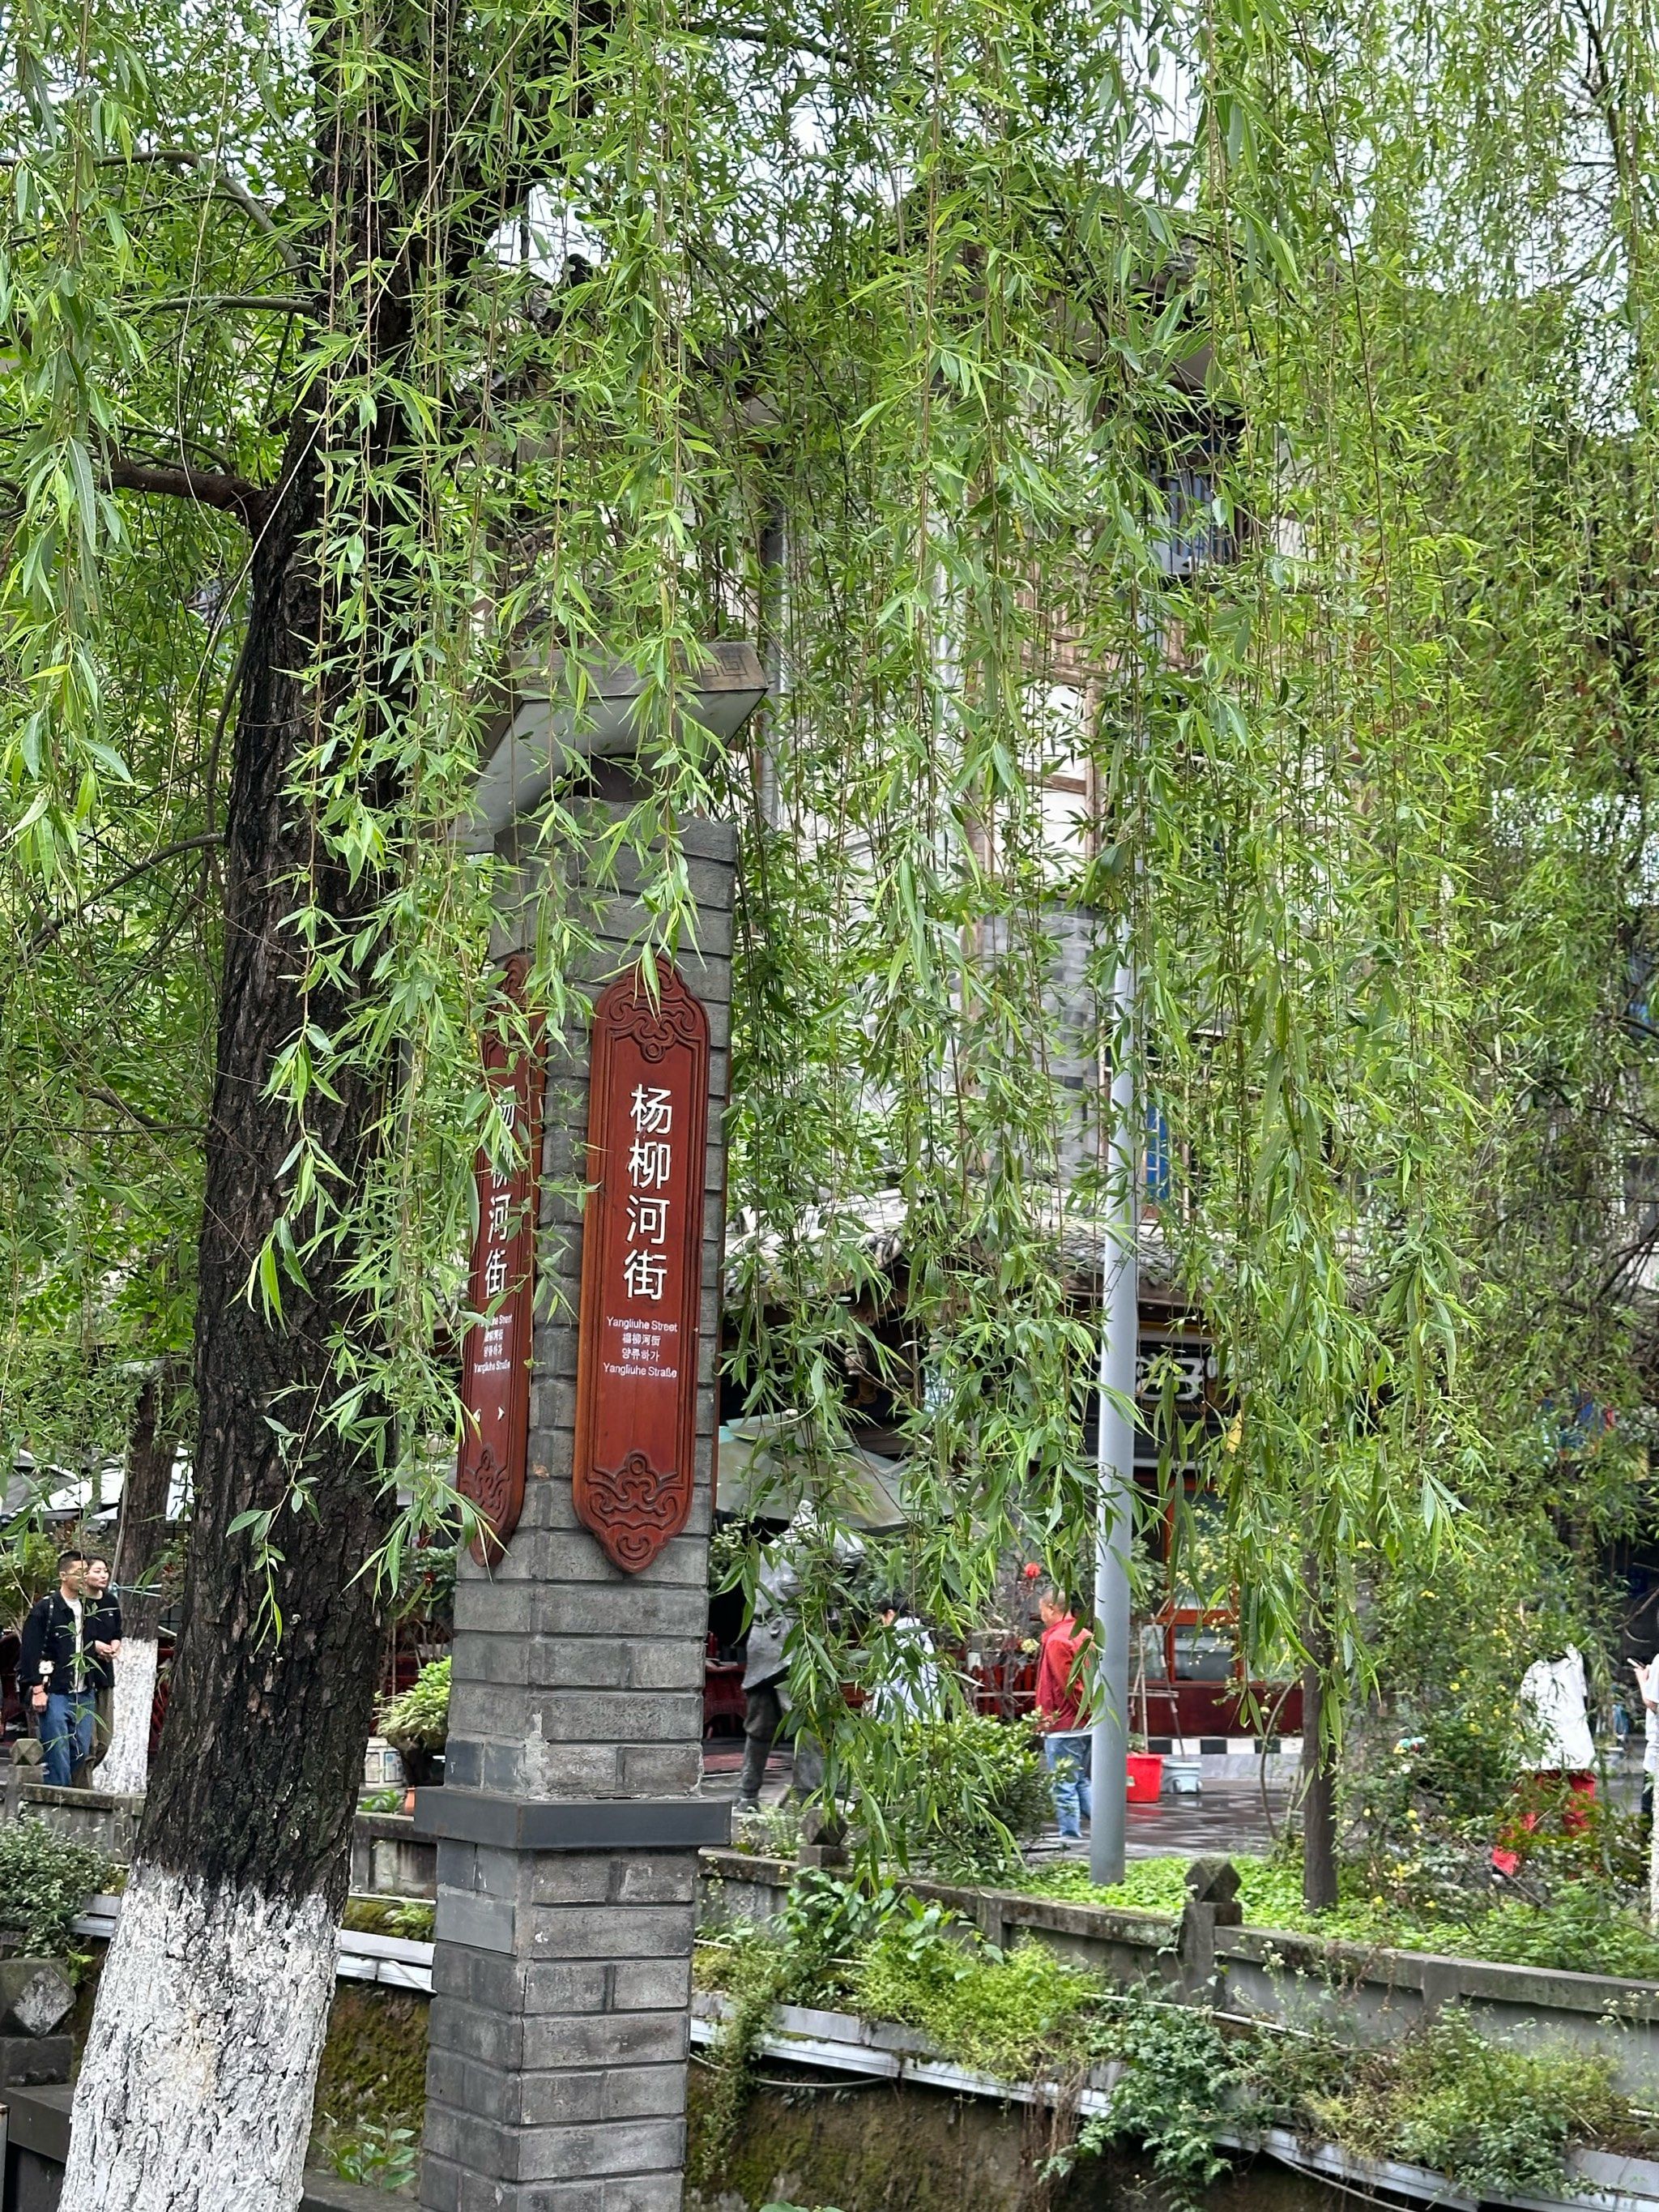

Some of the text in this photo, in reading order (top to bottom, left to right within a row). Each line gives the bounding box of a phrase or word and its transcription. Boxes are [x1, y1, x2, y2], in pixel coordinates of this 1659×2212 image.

[622, 1083, 673, 1301] 杨柳河街
[607, 1316, 678, 1333] Yangliuhe Street
[621, 1347, 660, 1362] 양류하가
[603, 1362, 678, 1378] Yangliuhe Straße
